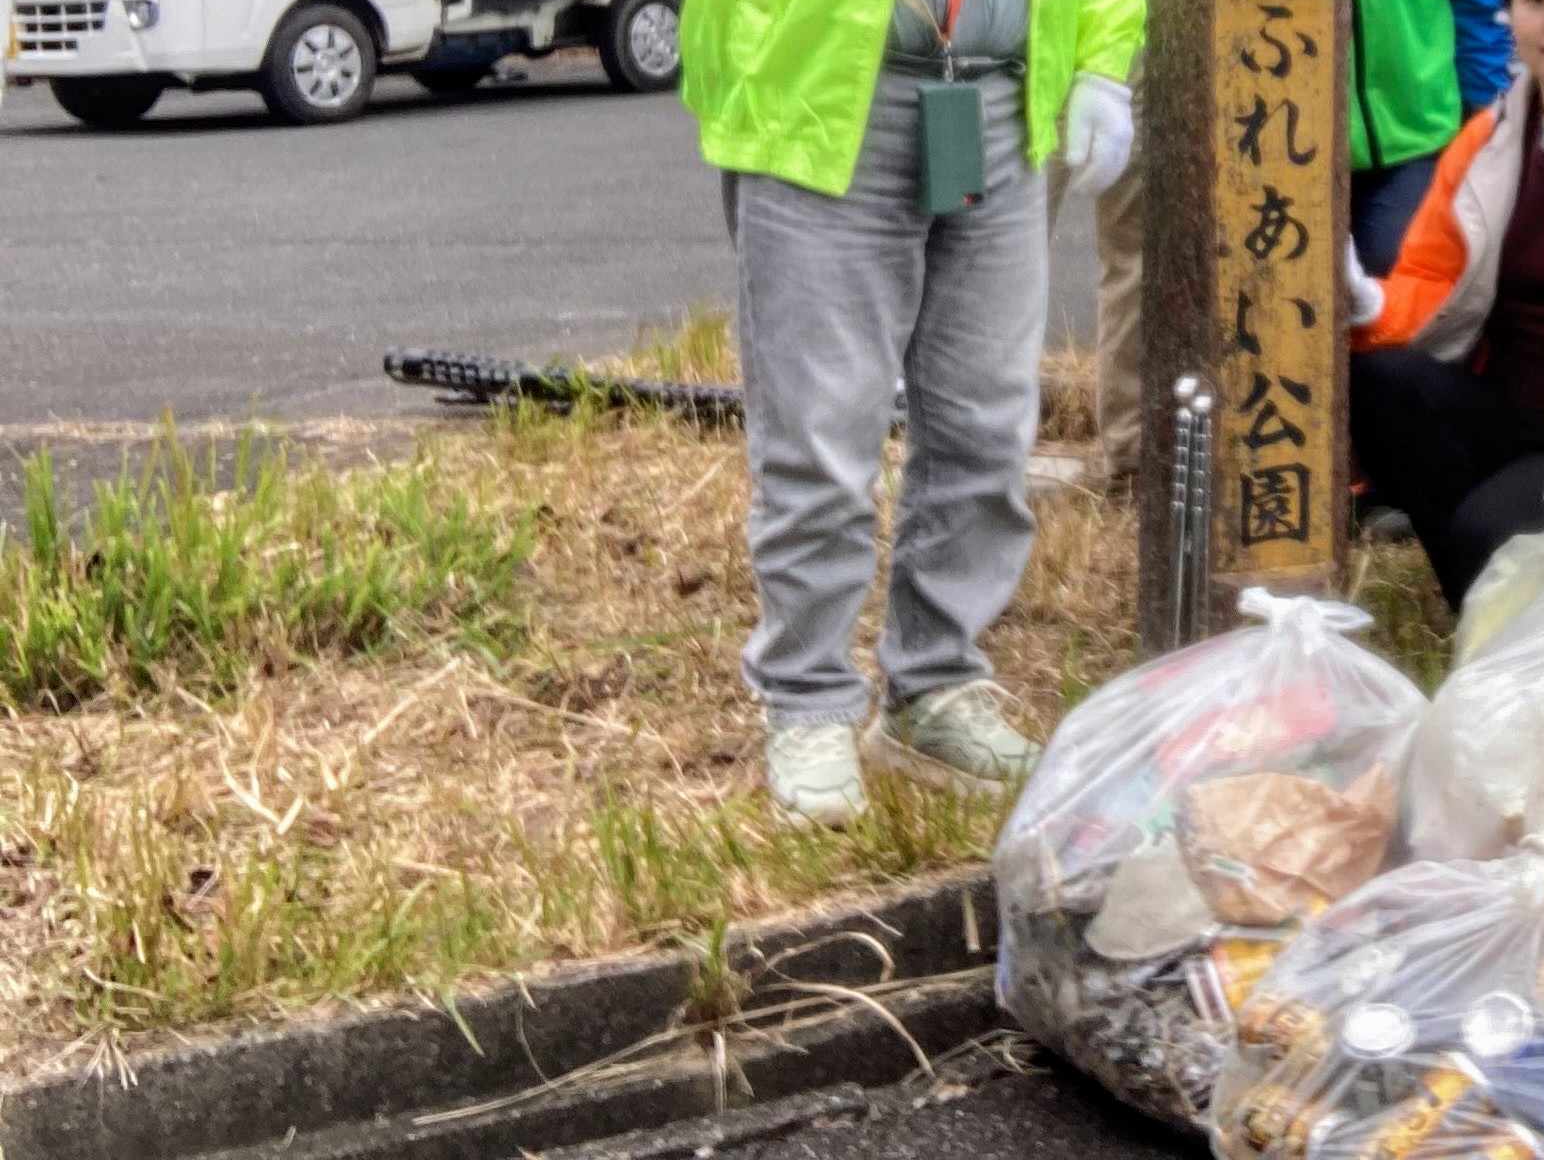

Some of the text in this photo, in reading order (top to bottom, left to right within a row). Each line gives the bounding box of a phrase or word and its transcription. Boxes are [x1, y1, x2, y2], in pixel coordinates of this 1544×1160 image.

[1235, 5, 1318, 546] ふれあい公園
